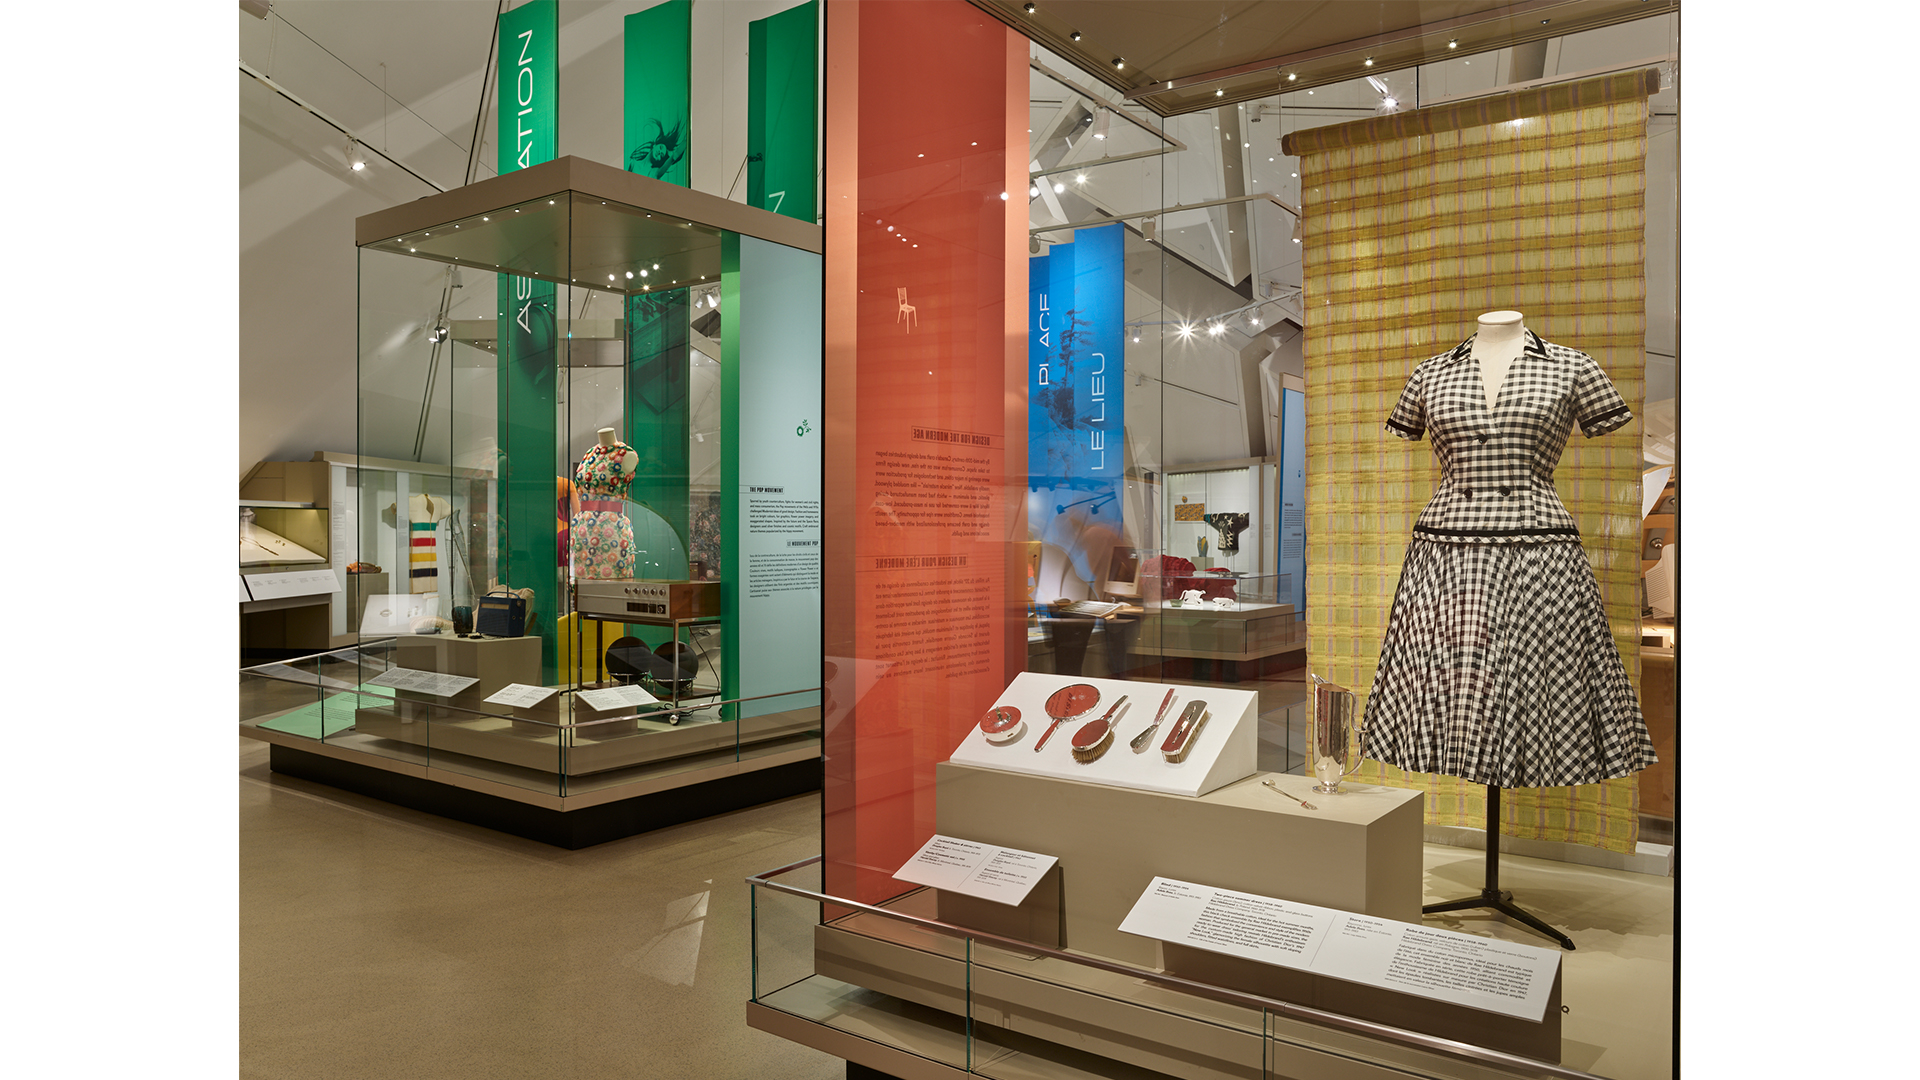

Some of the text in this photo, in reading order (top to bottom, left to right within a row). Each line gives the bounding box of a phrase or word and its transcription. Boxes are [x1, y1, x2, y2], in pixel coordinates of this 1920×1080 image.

[516, 29, 533, 335] ASATION
[1091, 352, 1105, 470] LE LIEU
